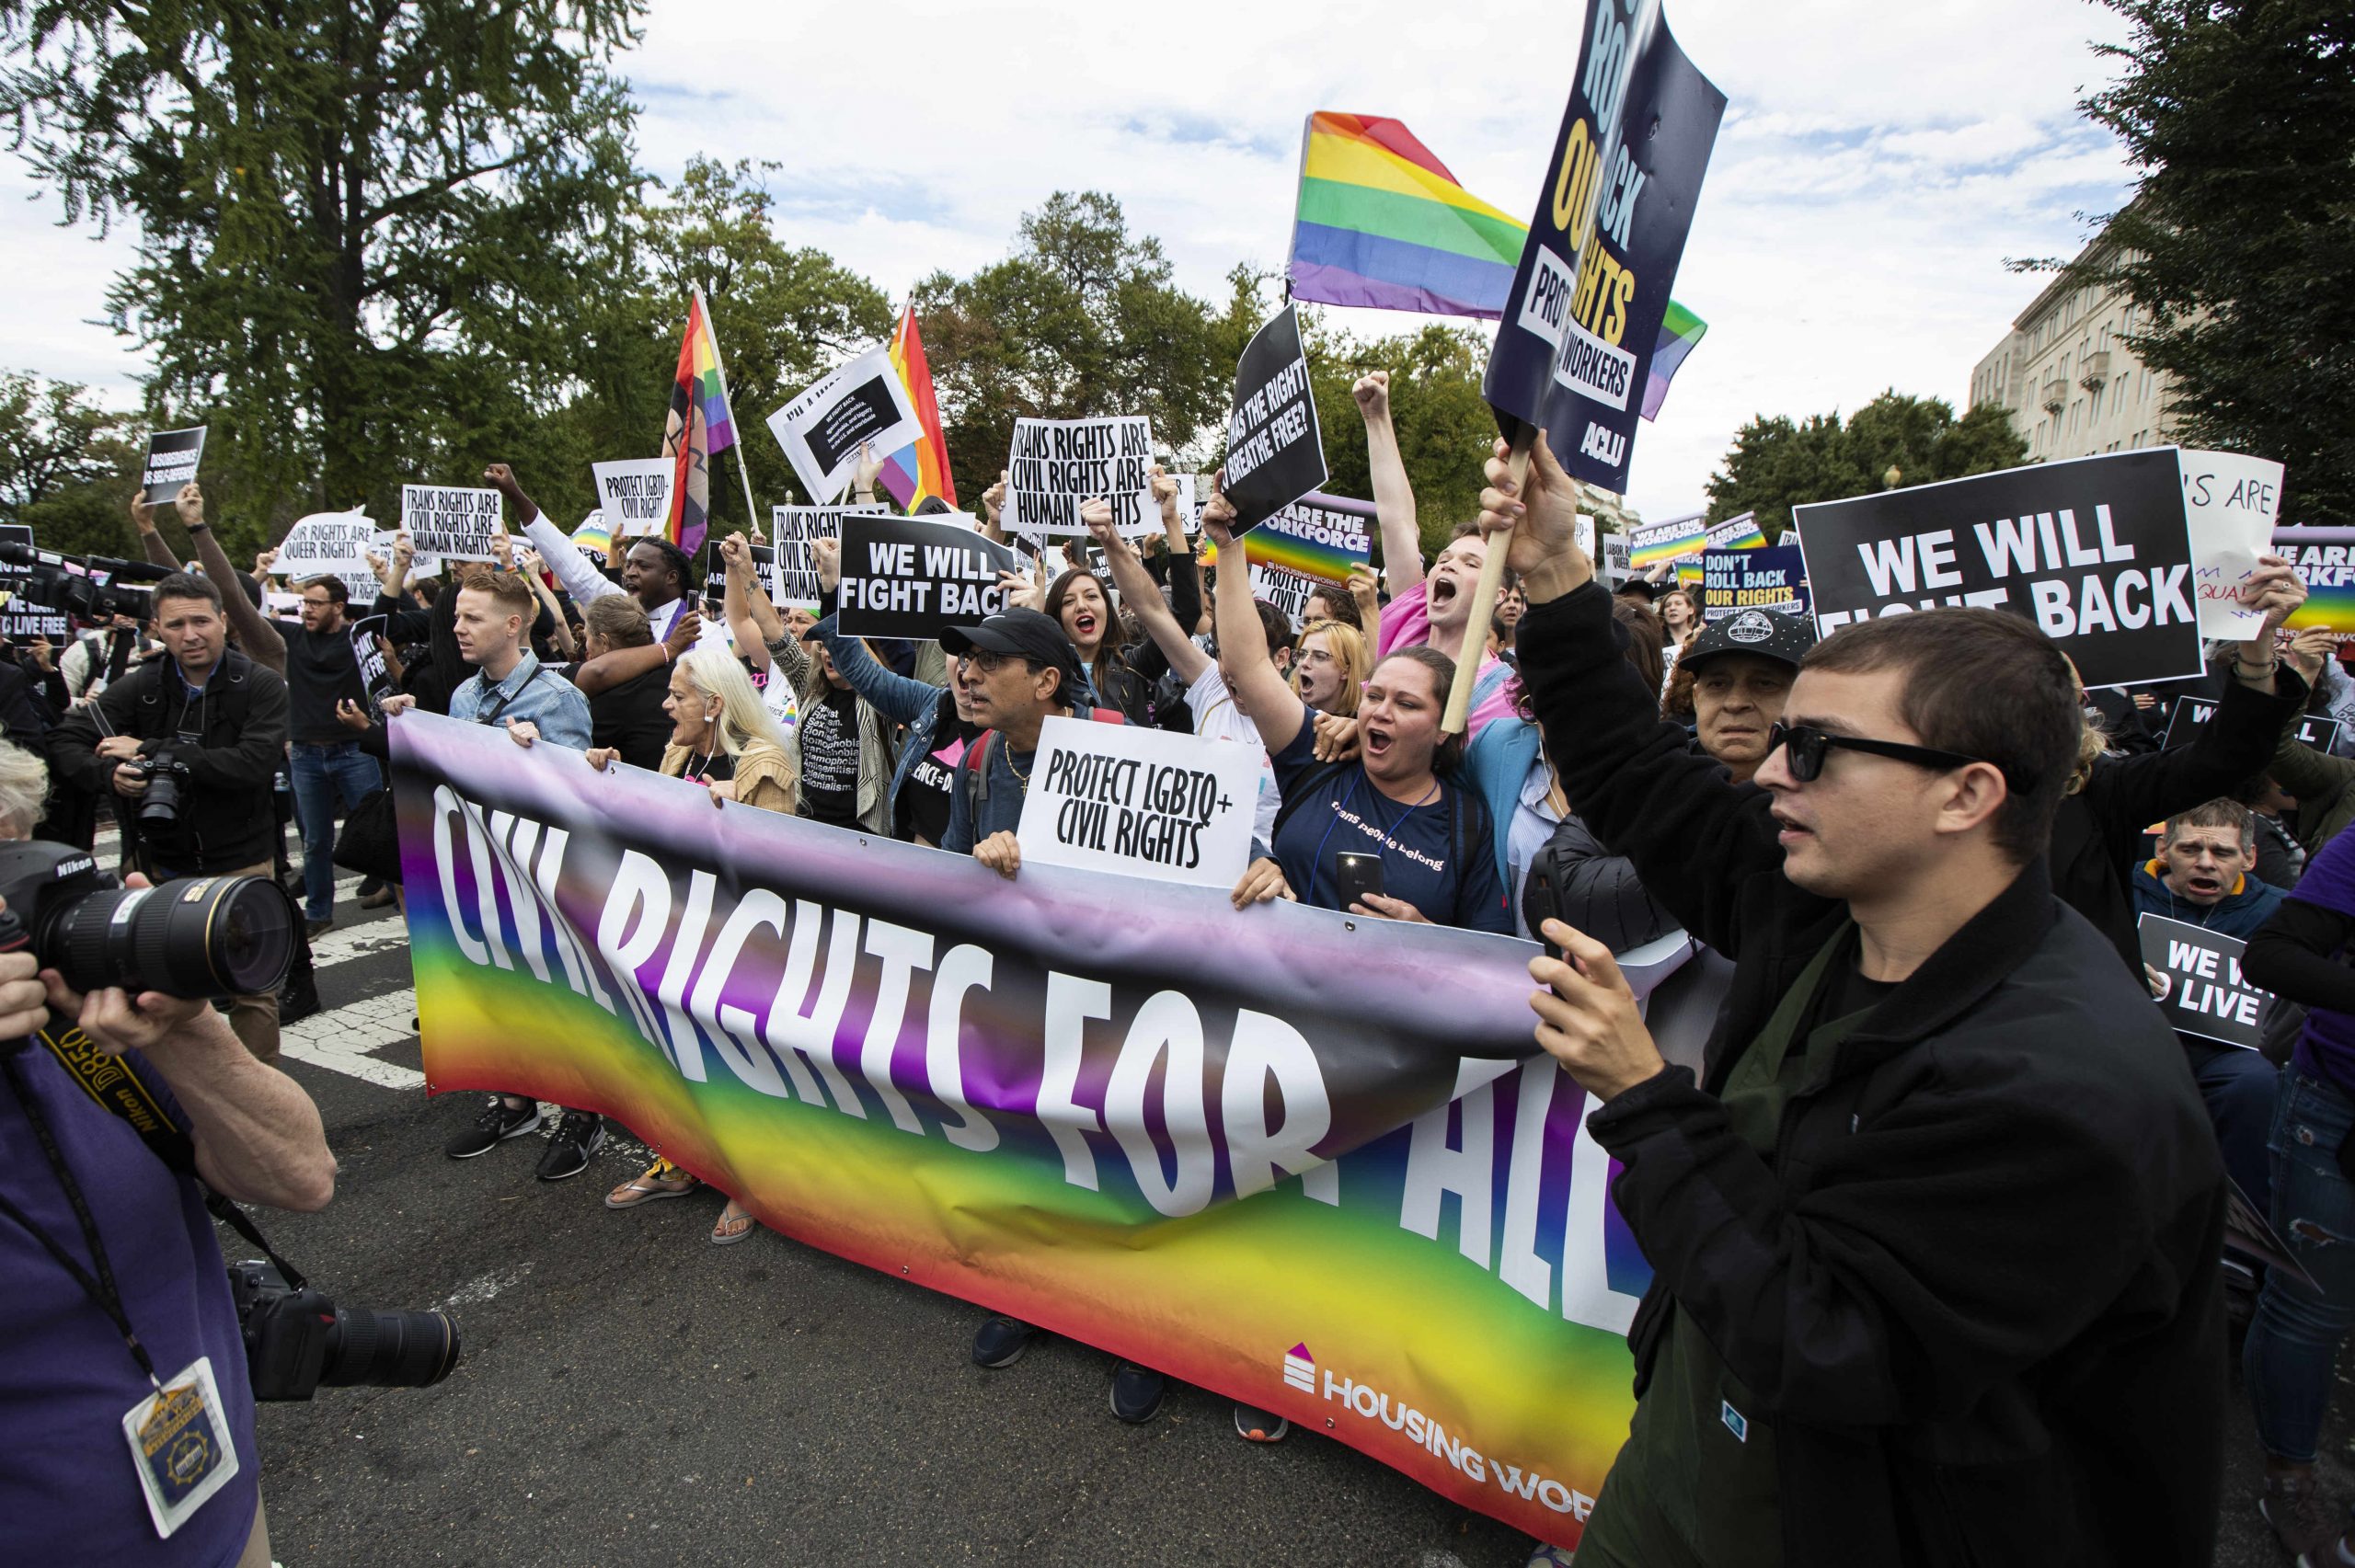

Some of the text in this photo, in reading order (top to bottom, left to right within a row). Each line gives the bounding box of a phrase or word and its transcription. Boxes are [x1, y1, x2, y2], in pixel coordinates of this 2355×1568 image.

[1562, 331, 1628, 397] WORKERS
[842, 395, 856, 407] BACK
[848, 415, 857, 424] and
[856, 406, 873, 418] bigotry
[1230, 357, 1305, 448] HAS THE RIGHT
[854, 413, 877, 429] worldwide
[1012, 423, 1149, 461] TRANS RIGHTS ARE
[1227, 428, 1274, 486] BREATHE
[1270, 400, 1308, 452] FREE?
[1580, 421, 1626, 467] ACLU
[144, 471, 153, 485] IS
[605, 475, 669, 499] PROTECT LGBTQ+
[1012, 460, 1045, 493] CIVIL
[1050, 459, 1110, 494] RIGHTS
[1116, 458, 1146, 490] ARE
[407, 489, 498, 514] TRANS RIGHTS ARE
[621, 498, 663, 519] CIVIL RIGHTS
[1017, 491, 1074, 526] HUMAN
[1079, 491, 1141, 526] RHTS
[2225, 479, 2273, 515] ARE
[409, 510, 493, 535] CIVIL RIGHTS ARE
[775, 511, 850, 541] TRANS RIGHT
[1284, 503, 1365, 534] ARE THE
[1637, 518, 1701, 540] WE ARE THE
[311, 524, 347, 541] RIGHTS
[350, 525, 371, 543] ARE
[413, 532, 490, 555] HUMAN RIGHTS
[1259, 516, 1370, 553] ORKFORCE
[1633, 524, 1705, 548] WORKFORCE
[284, 541, 356, 560] QUEER RIGHTS
[778, 541, 801, 570] CIVIL
[868, 542, 914, 577] WE
[924, 545, 996, 580] WILL
[1605, 543, 1624, 555] LABOR
[1613, 555, 1630, 570] QUEER
[1706, 555, 1752, 571] DON'T
[1857, 504, 2134, 596] WE WILL
[1275, 563, 1342, 589] HOUSING WORKS
[1706, 569, 1786, 589] ROLL BACK
[840, 577, 931, 613] FIGHT
[1269, 586, 1296, 615] CIVIL
[1706, 587, 1794, 606] OUR RIGHTS
[2031, 564, 2195, 638] BACK
[14, 616, 40, 635] LIVE
[41, 616, 66, 635] FREE
[1706, 608, 1737, 618] PROTECT
[368, 650, 386, 679] FRE
[811, 709, 843, 727] Racsm.
[1043, 748, 1234, 828] PROTECT LGBTQ+
[1057, 798, 1203, 869] CIVIL RIGHTS
[1330, 801, 1444, 872] trans people belong
[56, 855, 93, 878] Nikon
[2168, 940, 2220, 979] WE
[2178, 979, 2259, 1026] LIVE
[434, 784, 1640, 1338] CIVIL RIGHTS FOR ALL
[59, 1026, 159, 1134] Nikon D850
[1324, 1369, 1594, 1523] HOUSING WOR
